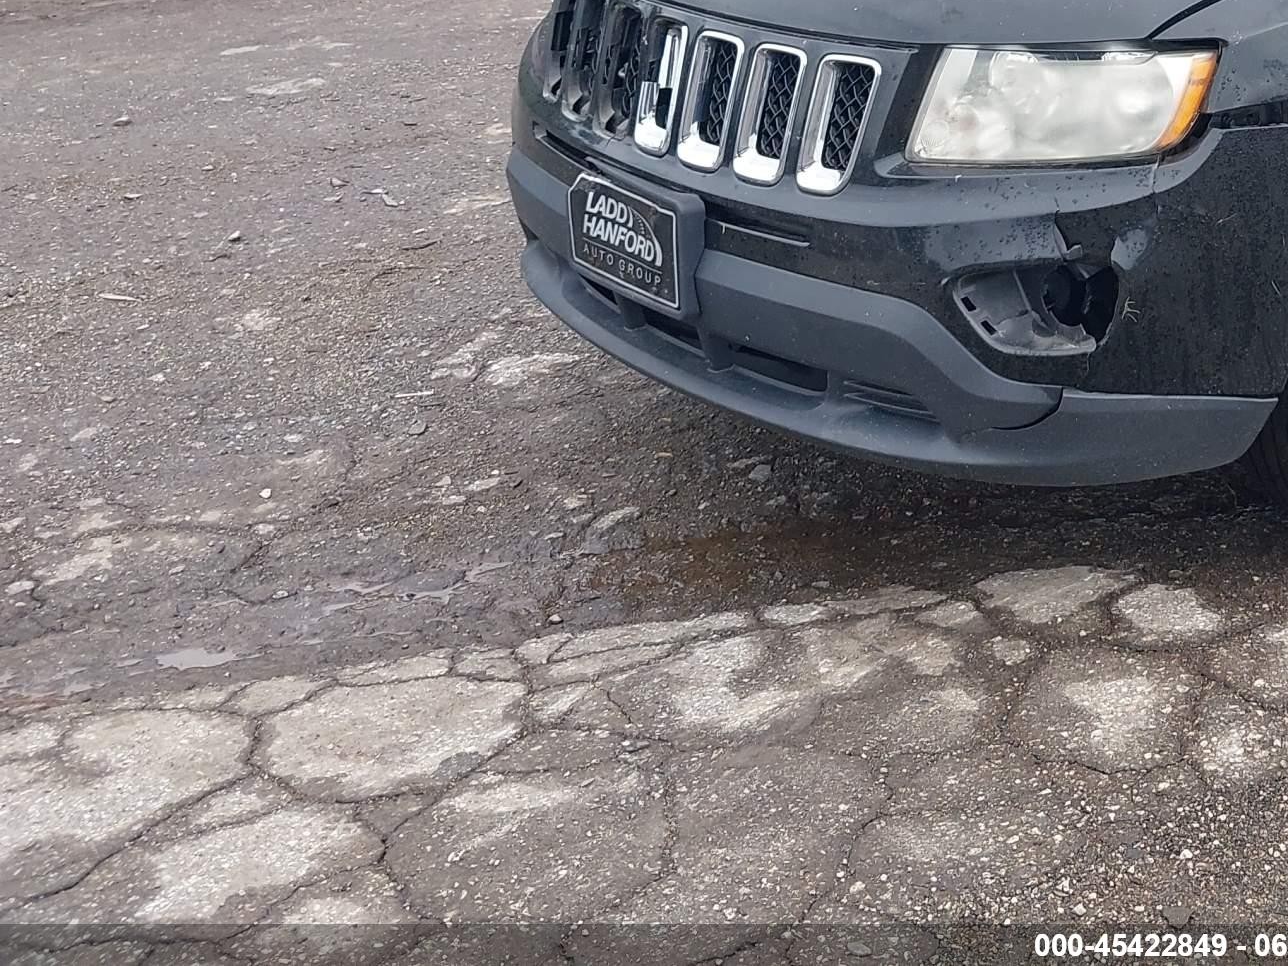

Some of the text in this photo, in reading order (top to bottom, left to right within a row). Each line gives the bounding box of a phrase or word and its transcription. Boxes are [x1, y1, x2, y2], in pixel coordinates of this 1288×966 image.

[585, 191, 628, 224] LADD
[583, 214, 655, 262] HANFORD
[583, 244, 662, 285] AUTO GROUP
